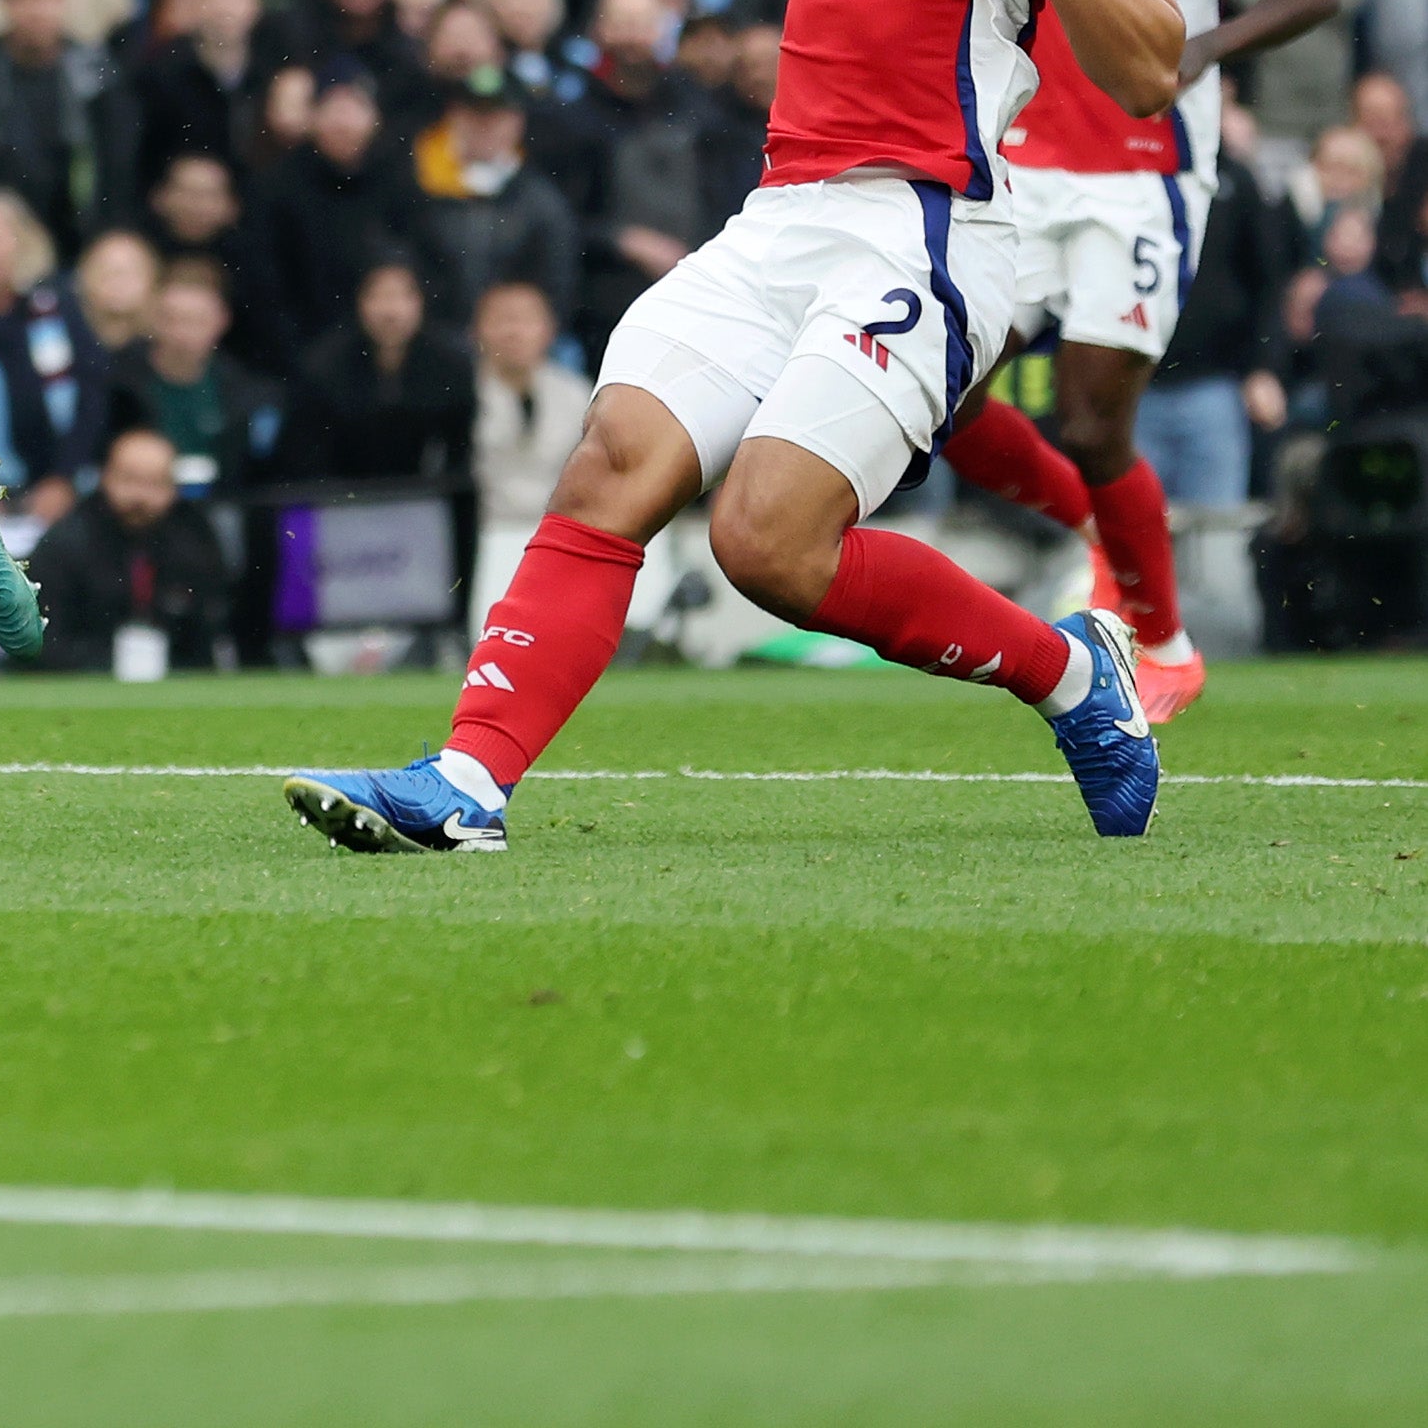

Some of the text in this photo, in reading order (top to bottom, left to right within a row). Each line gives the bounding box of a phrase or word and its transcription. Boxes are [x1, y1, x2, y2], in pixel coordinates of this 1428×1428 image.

[1133, 235, 1159, 294] 5
[862, 287, 922, 335] 2
[479, 625, 535, 647] FC
